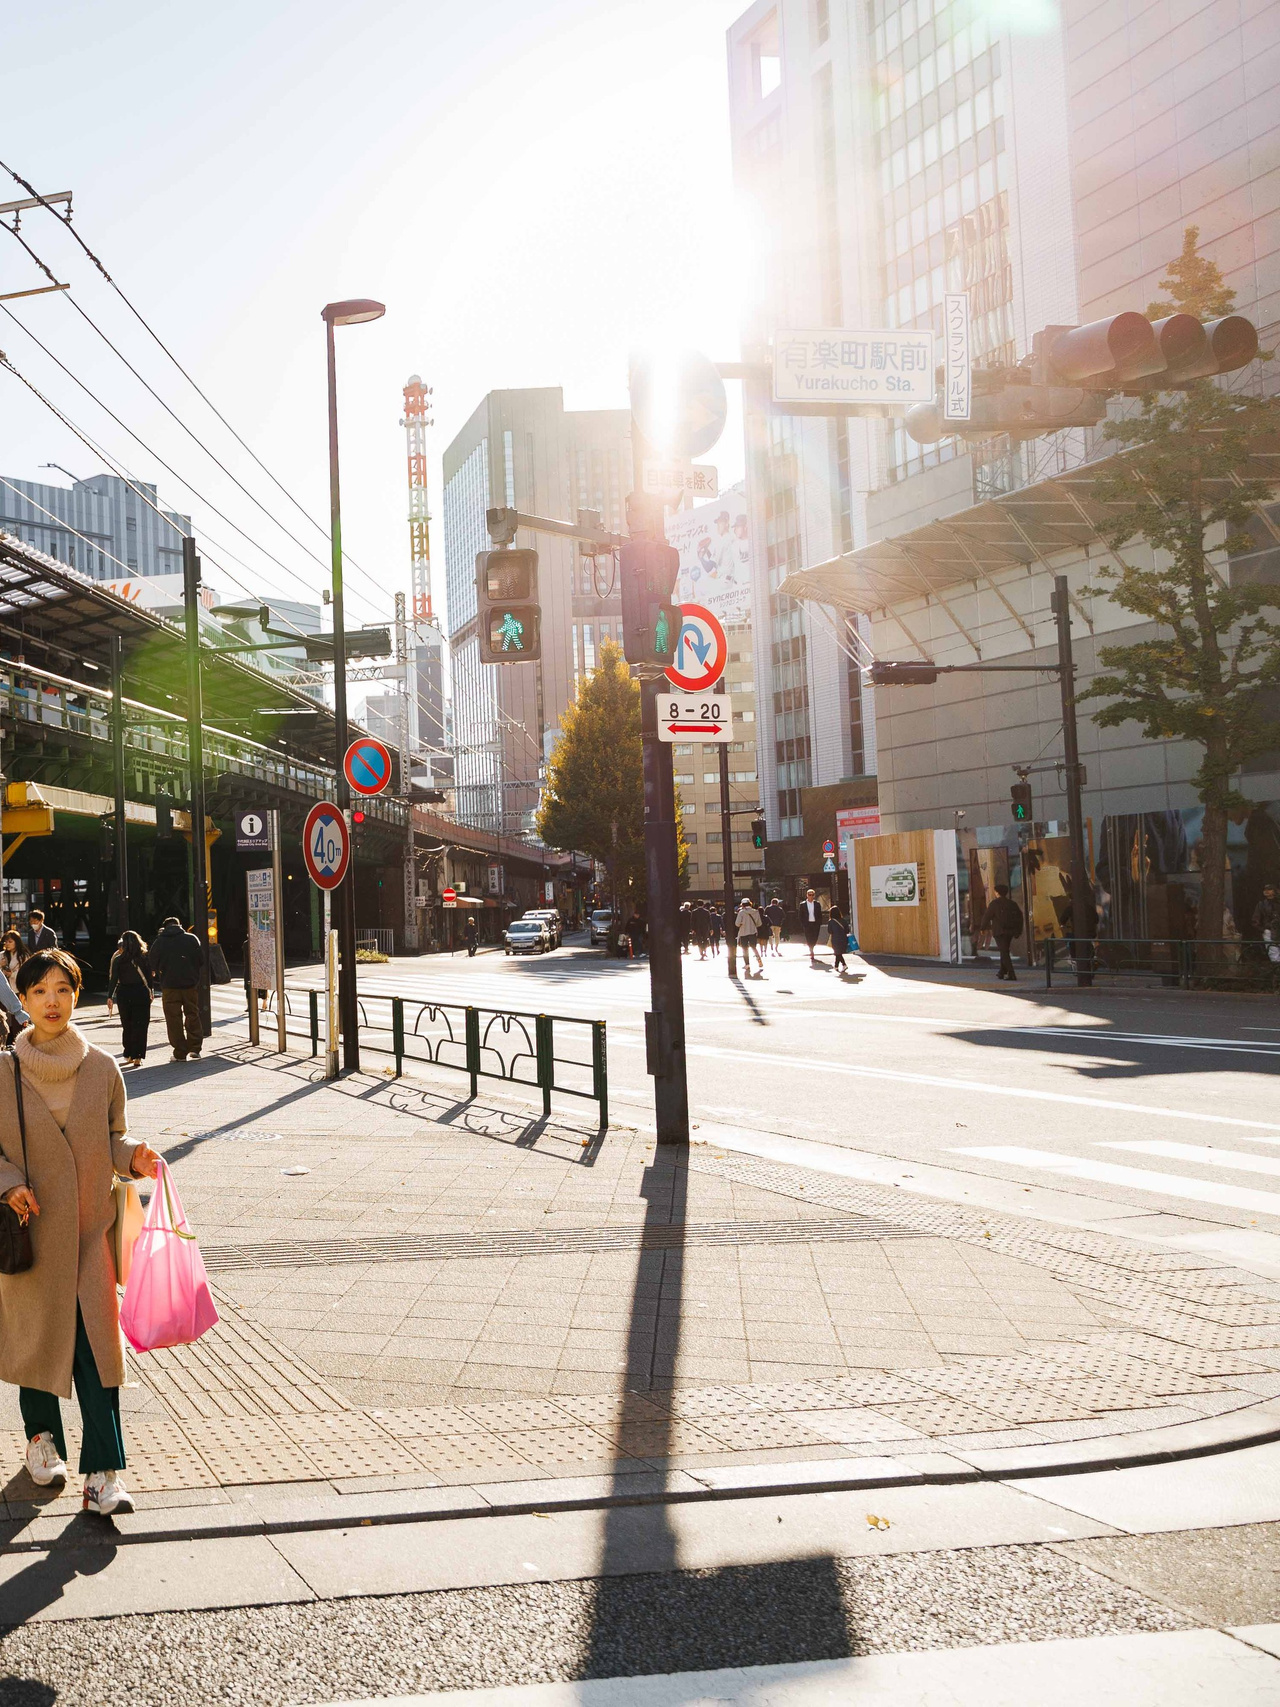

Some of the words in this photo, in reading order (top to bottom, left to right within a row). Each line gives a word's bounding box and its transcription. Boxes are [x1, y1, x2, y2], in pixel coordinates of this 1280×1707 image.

[780, 338, 929, 372] 有楽町駅前
[949, 299, 966, 413] スクランブル式
[795, 374, 879, 392] Yurakucho
[885, 375, 915, 392] Sta.
